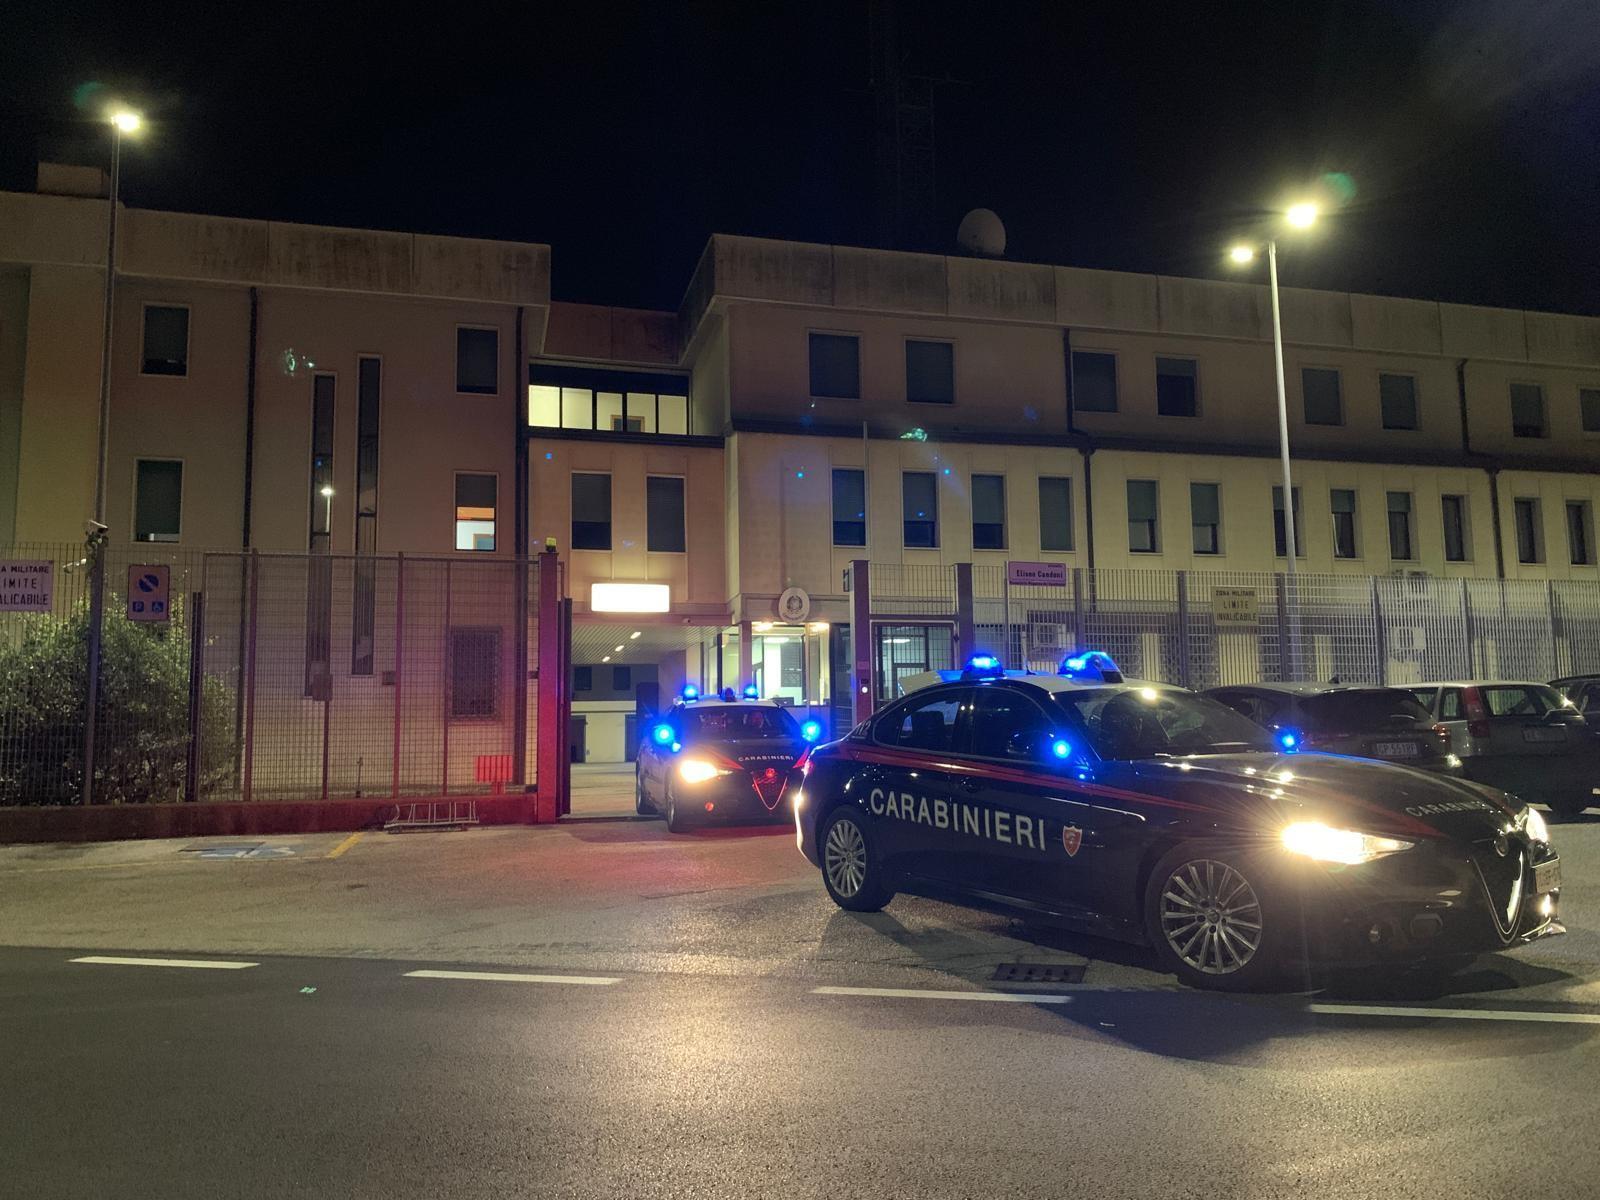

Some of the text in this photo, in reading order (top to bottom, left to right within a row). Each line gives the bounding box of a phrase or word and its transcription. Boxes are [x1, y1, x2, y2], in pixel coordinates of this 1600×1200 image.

[11, 566, 49, 574] MILITARE
[1223, 600, 1249, 609] LIMITE
[1216, 612, 1257, 621] INVALICABILE
[738, 755, 794, 763] CARABINIERI
[870, 787, 1046, 851] CARABINIERI
